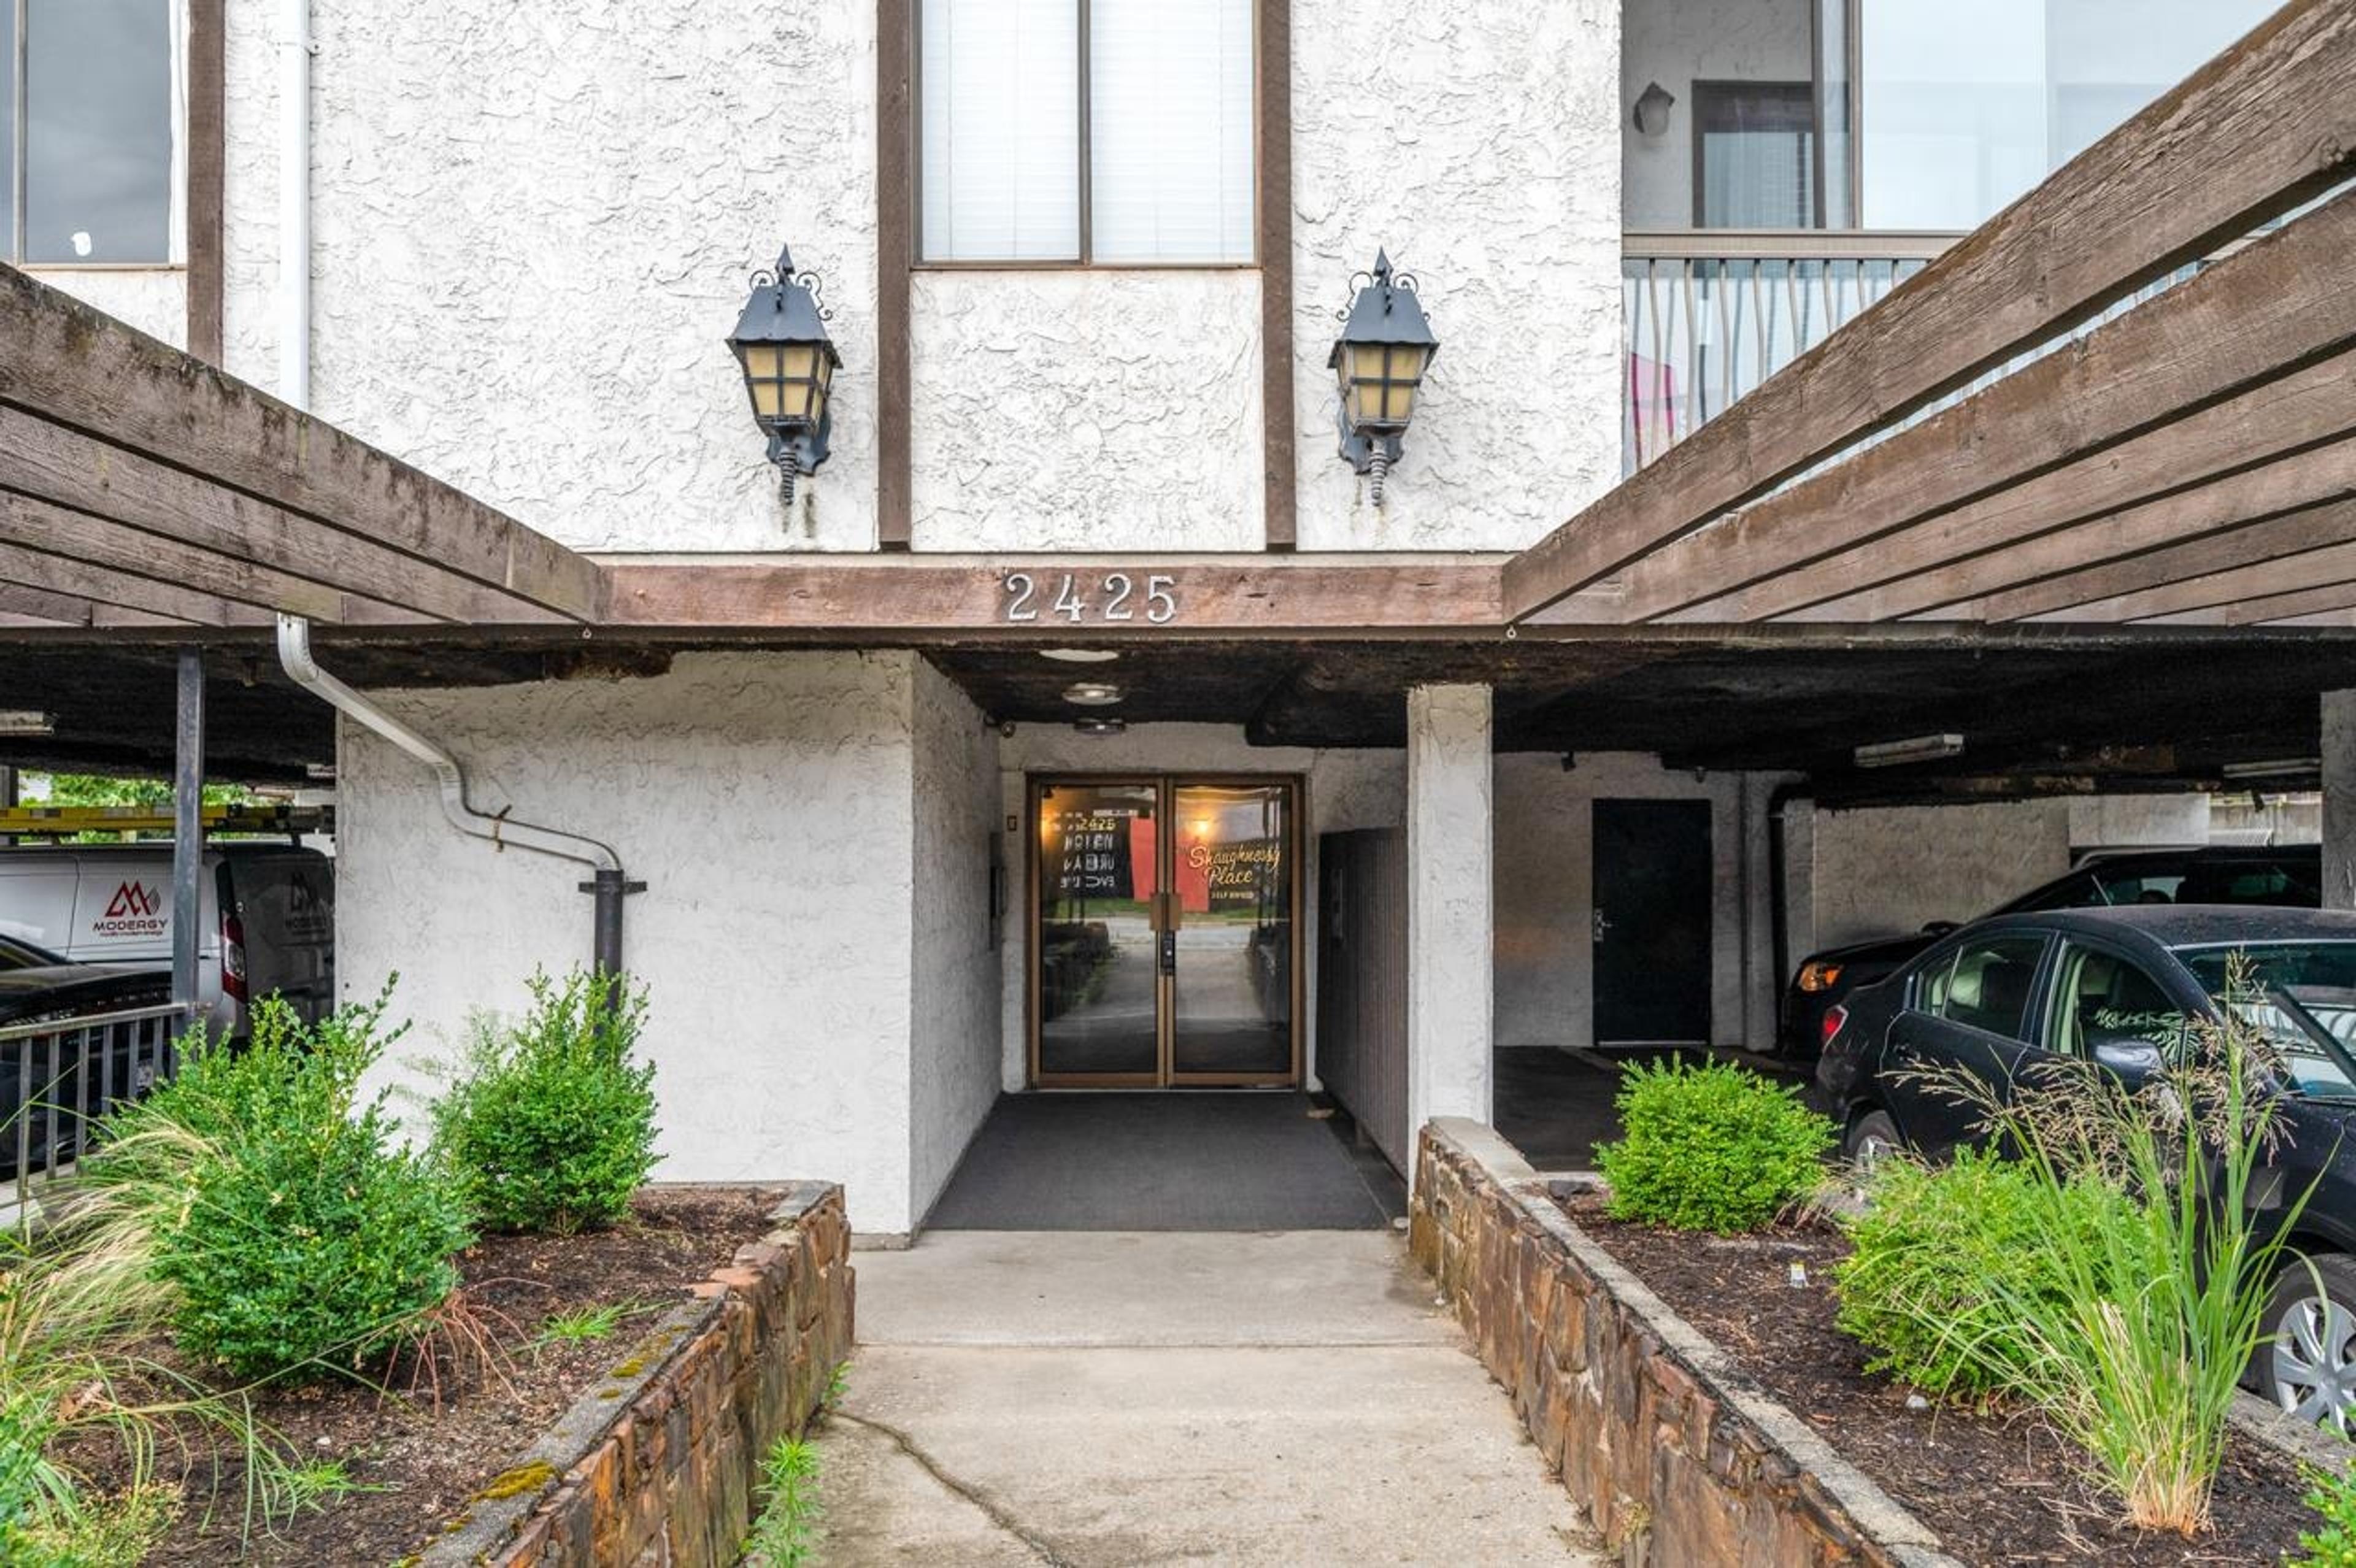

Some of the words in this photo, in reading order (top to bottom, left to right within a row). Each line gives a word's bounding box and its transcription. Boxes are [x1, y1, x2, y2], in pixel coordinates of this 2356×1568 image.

[1006, 573, 1176, 623] 2425
[1204, 864, 1253, 888] Place
[92, 919, 168, 931] MODERGY
